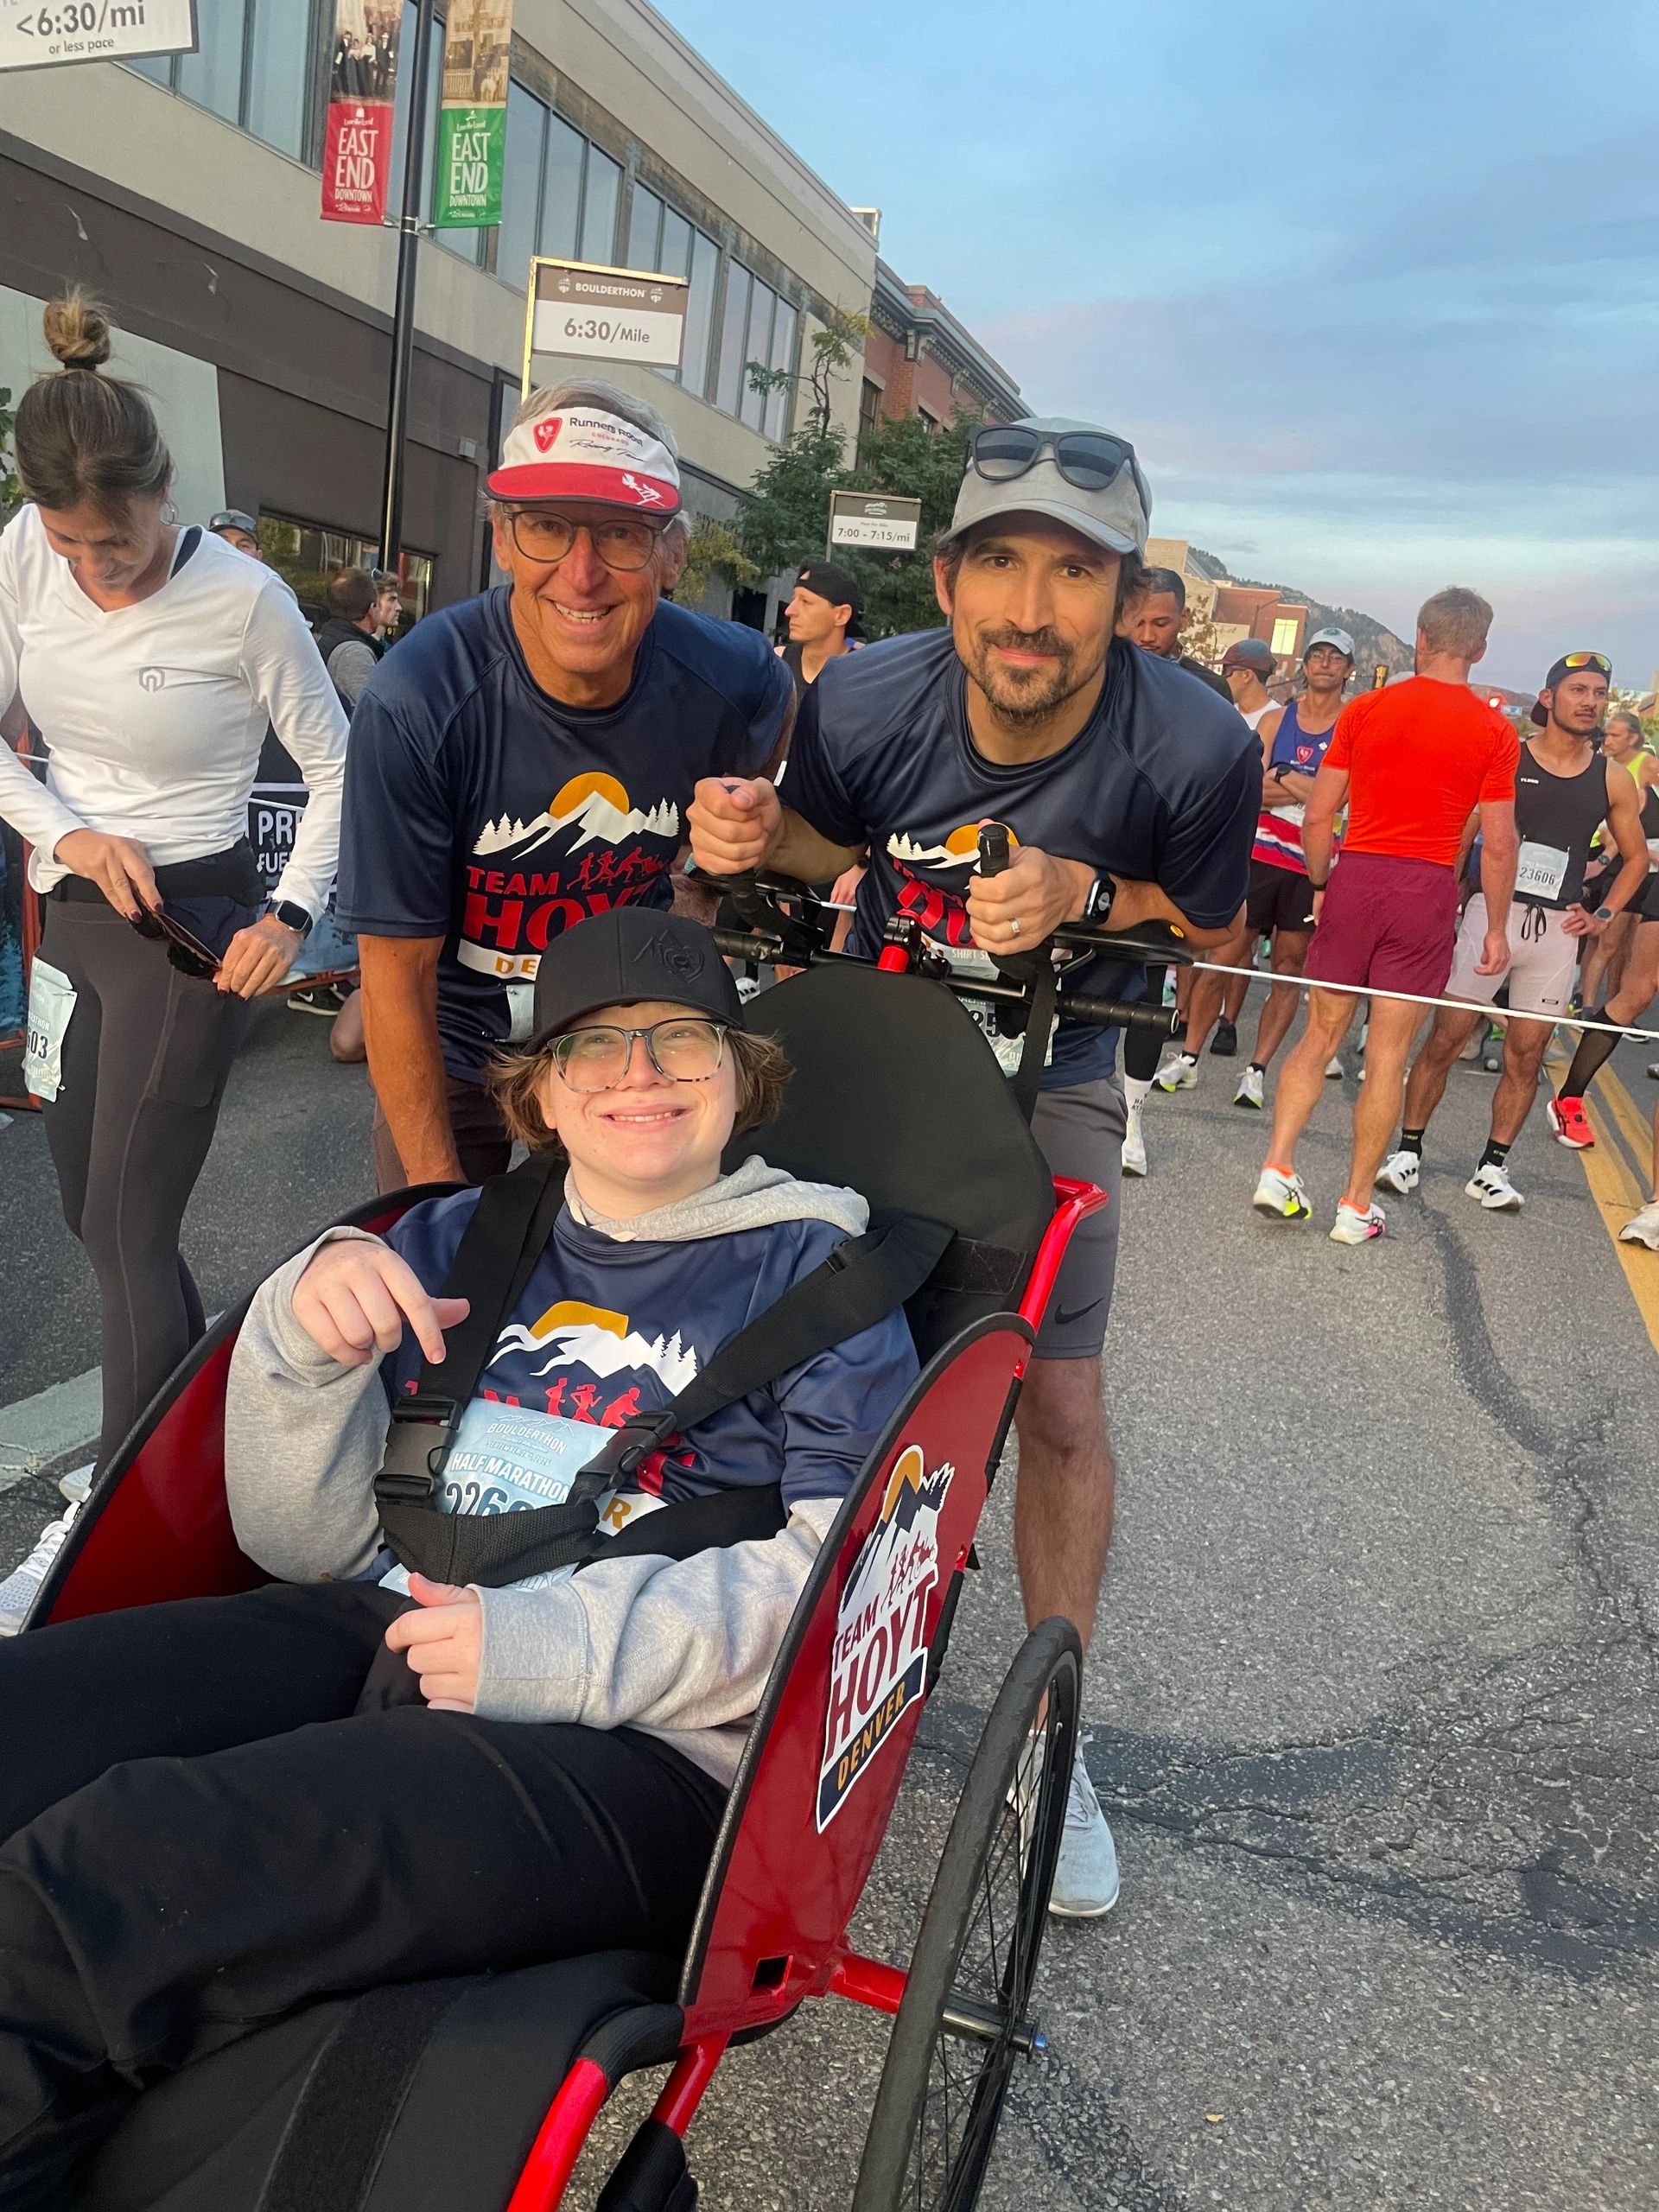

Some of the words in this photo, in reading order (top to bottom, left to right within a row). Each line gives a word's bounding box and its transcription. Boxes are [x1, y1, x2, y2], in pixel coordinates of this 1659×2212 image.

[48, 44, 60, 54] or
[64, 41, 85, 53] less
[87, 38, 115, 53] pace
[338, 127, 378, 157] EAST
[452, 132, 491, 162] EAST
[335, 155, 375, 189] END
[450, 162, 488, 194] END
[334, 188, 372, 203] DOWNTOWN
[449, 194, 486, 207] DOWNTOWN
[575, 283, 645, 298] BOULDERTHON
[564, 318, 650, 343] 6:30/Mile
[570, 417, 616, 434] Runners
[838, 528, 860, 537] 7:00
[871, 531, 910, 543] 7:15/mi
[258, 810, 302, 846] PR
[259, 851, 291, 873] FUE
[467, 866, 559, 896] TEAM
[1520, 867, 1555, 885] 23606
[495, 957, 537, 975] DE
[951, 950, 979, 961] SHIRT
[486, 1423, 567, 1455] BOULDERTHON
[486, 1440, 520, 1455] SEPTEMBER
[450, 1452, 489, 1471] HALF
[484, 1457, 569, 1503] MARATHON
[835, 1594, 879, 1674] TEAM
[824, 1570, 937, 1764] HOYT
[837, 1681, 906, 1791] DENVER
